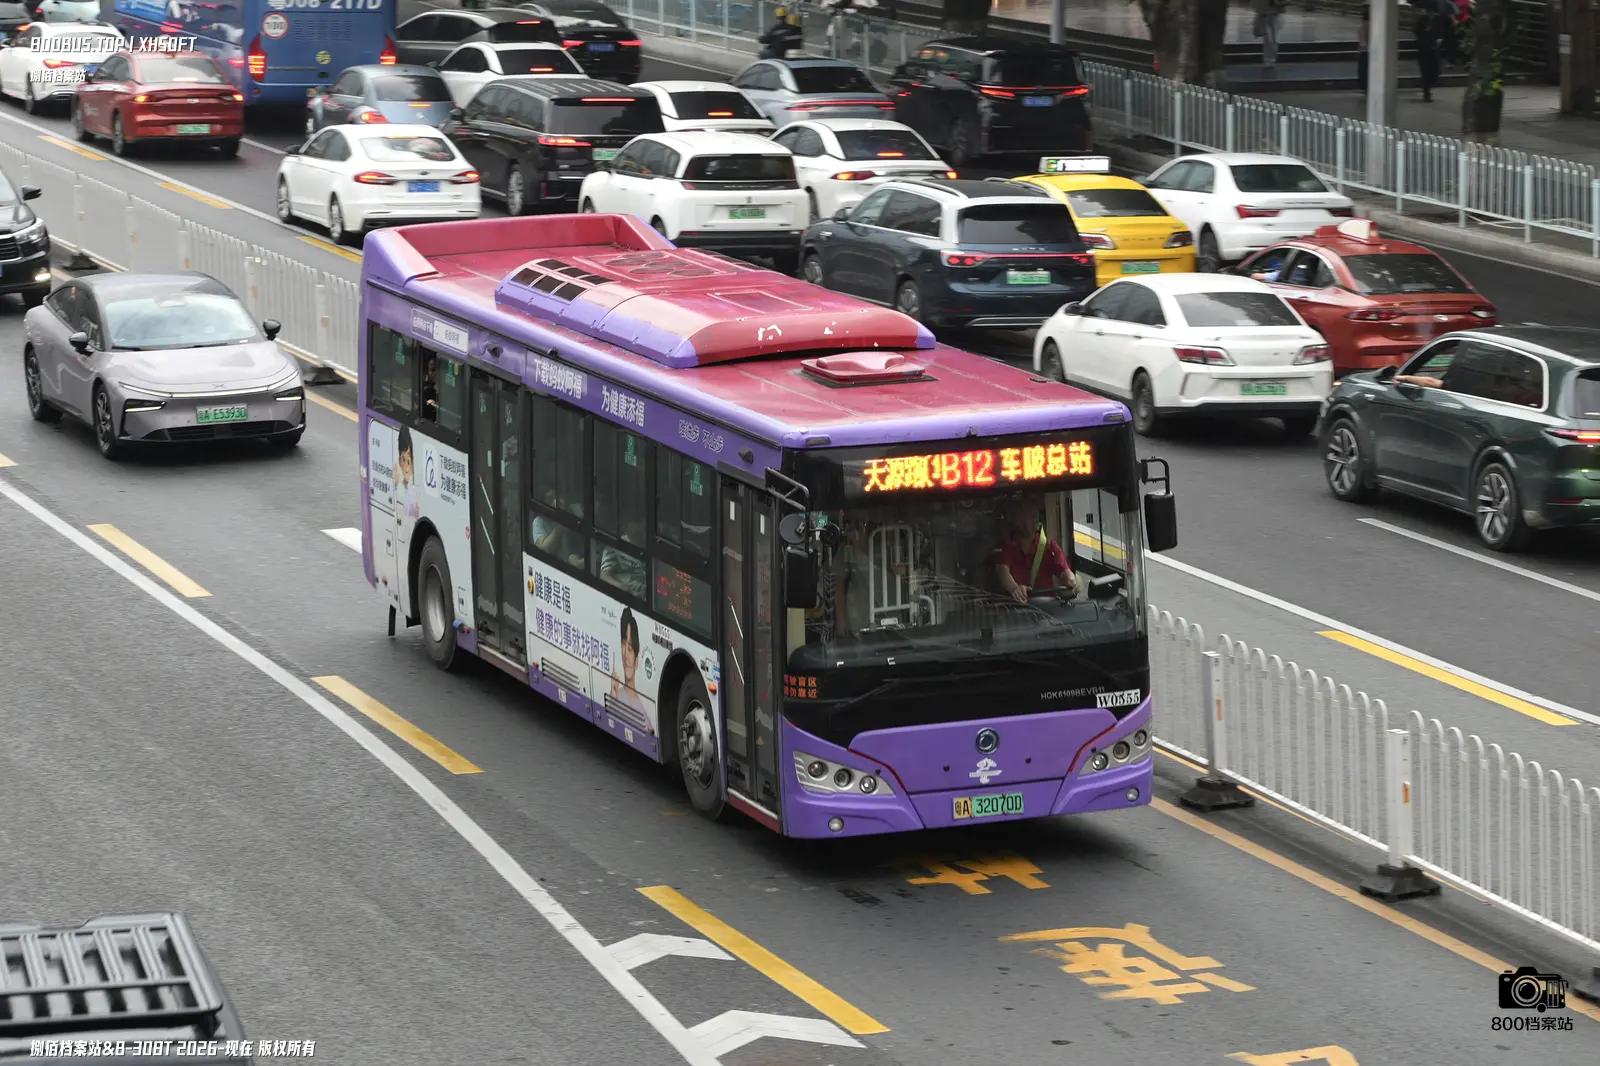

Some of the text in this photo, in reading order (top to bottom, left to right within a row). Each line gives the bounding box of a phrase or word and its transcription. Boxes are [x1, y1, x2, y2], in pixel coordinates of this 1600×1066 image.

[534, 359, 645, 428] 下载蚂蚁阿福 为健康添福
[942, 451, 994, 488] B12
[1000, 441, 1093, 481] 车陂总站
[535, 606, 610, 672] 健康的事就找阿福
